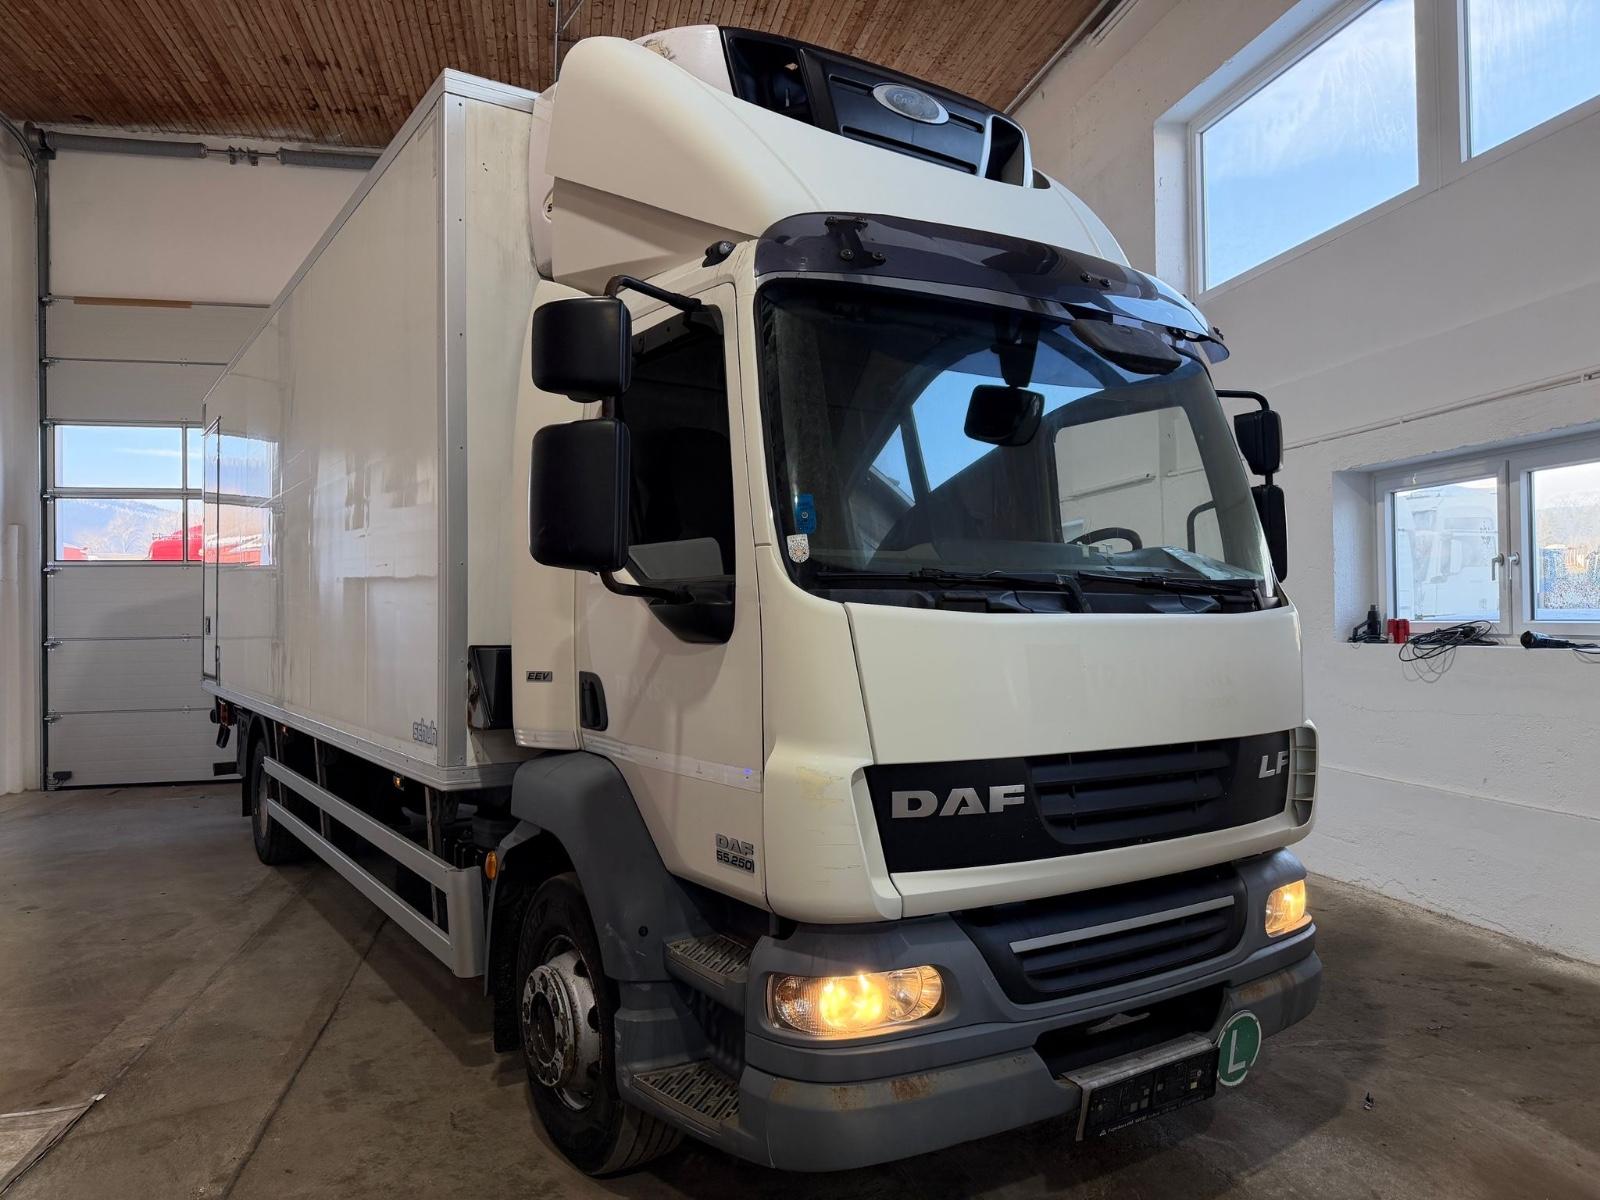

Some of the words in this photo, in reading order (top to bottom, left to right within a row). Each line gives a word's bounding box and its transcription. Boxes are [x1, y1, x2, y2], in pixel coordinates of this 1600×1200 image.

[527, 671, 551, 681] EEV
[1258, 750, 1288, 779] LF
[891, 784, 1025, 819] DAF
[715, 833, 754, 857] DAF
[1228, 1029, 1247, 1074] L
